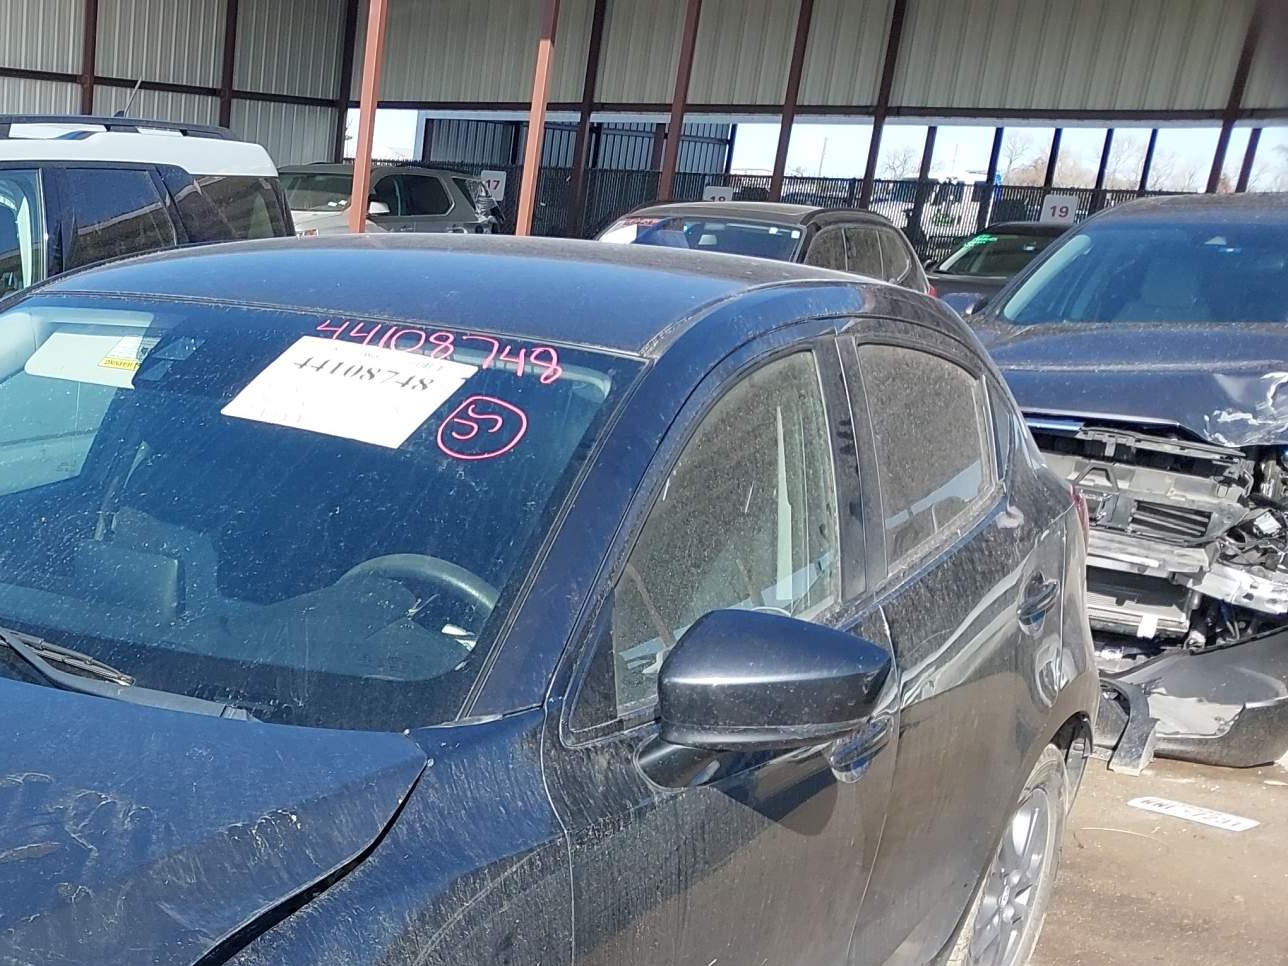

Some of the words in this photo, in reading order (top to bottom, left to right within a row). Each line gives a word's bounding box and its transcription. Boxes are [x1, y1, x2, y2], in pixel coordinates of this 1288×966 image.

[485, 179, 500, 190] 17
[1050, 205, 1070, 218] 19
[316, 319, 563, 384] 44108748
[293, 356, 435, 391] 44108748
